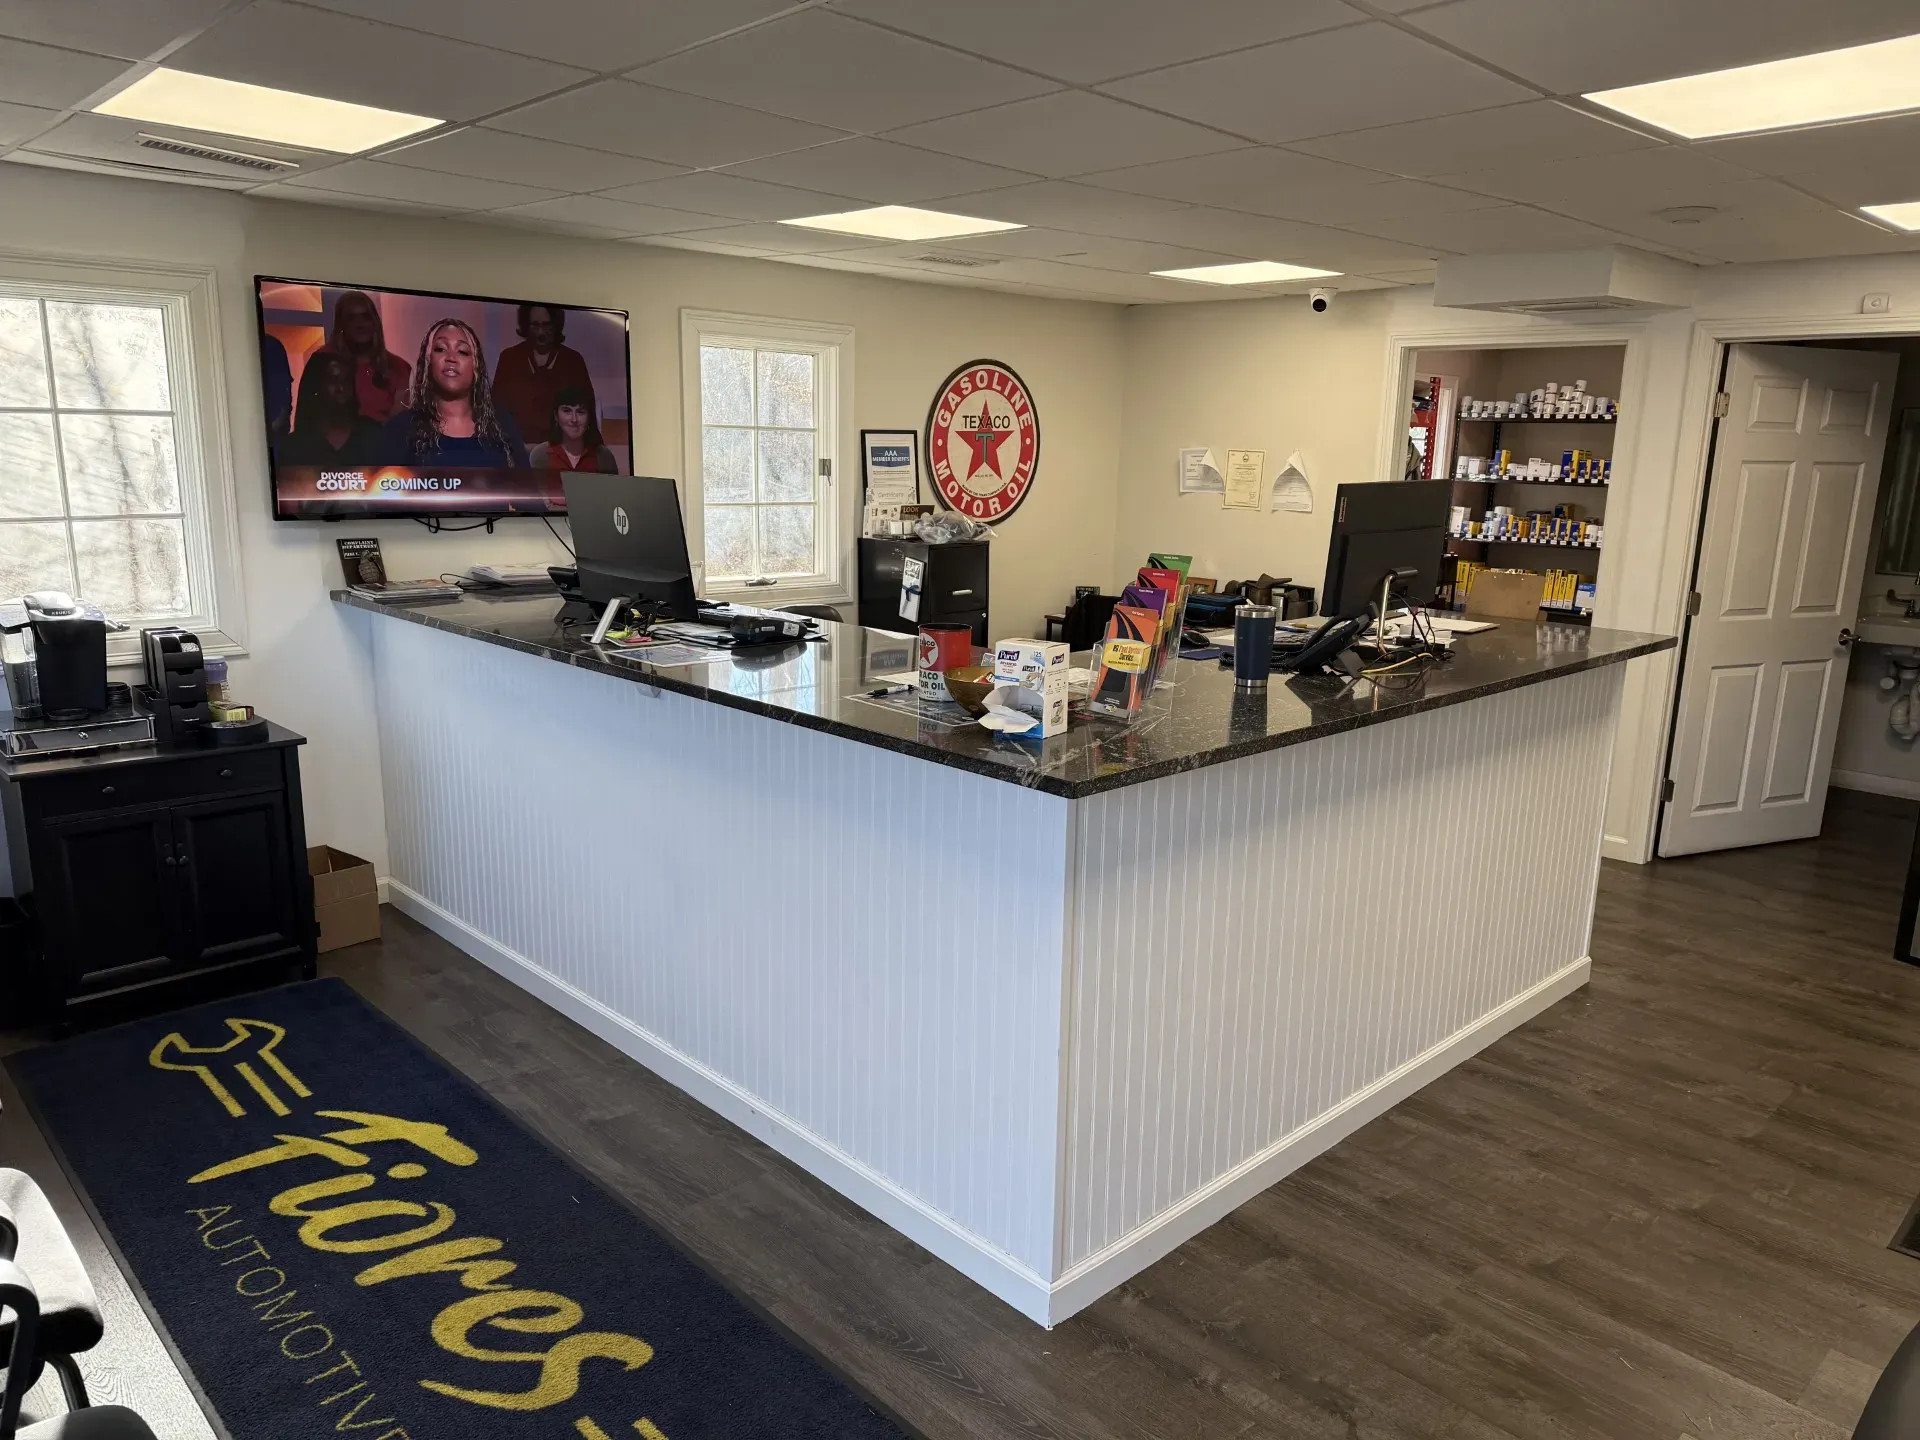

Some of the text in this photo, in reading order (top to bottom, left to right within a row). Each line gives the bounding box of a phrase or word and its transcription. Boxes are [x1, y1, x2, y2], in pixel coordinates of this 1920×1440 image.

[937, 370, 1032, 430] GASOLINE
[962, 415, 1011, 429] TEXACO
[320, 472, 364, 480] DIVORCE
[316, 479, 368, 491] COURT
[378, 478, 462, 491] COMING UP
[935, 458, 1031, 517] MOTOR OIL
[931, 682, 946, 691] OIL
[187, 1110, 654, 1411] Fiores
